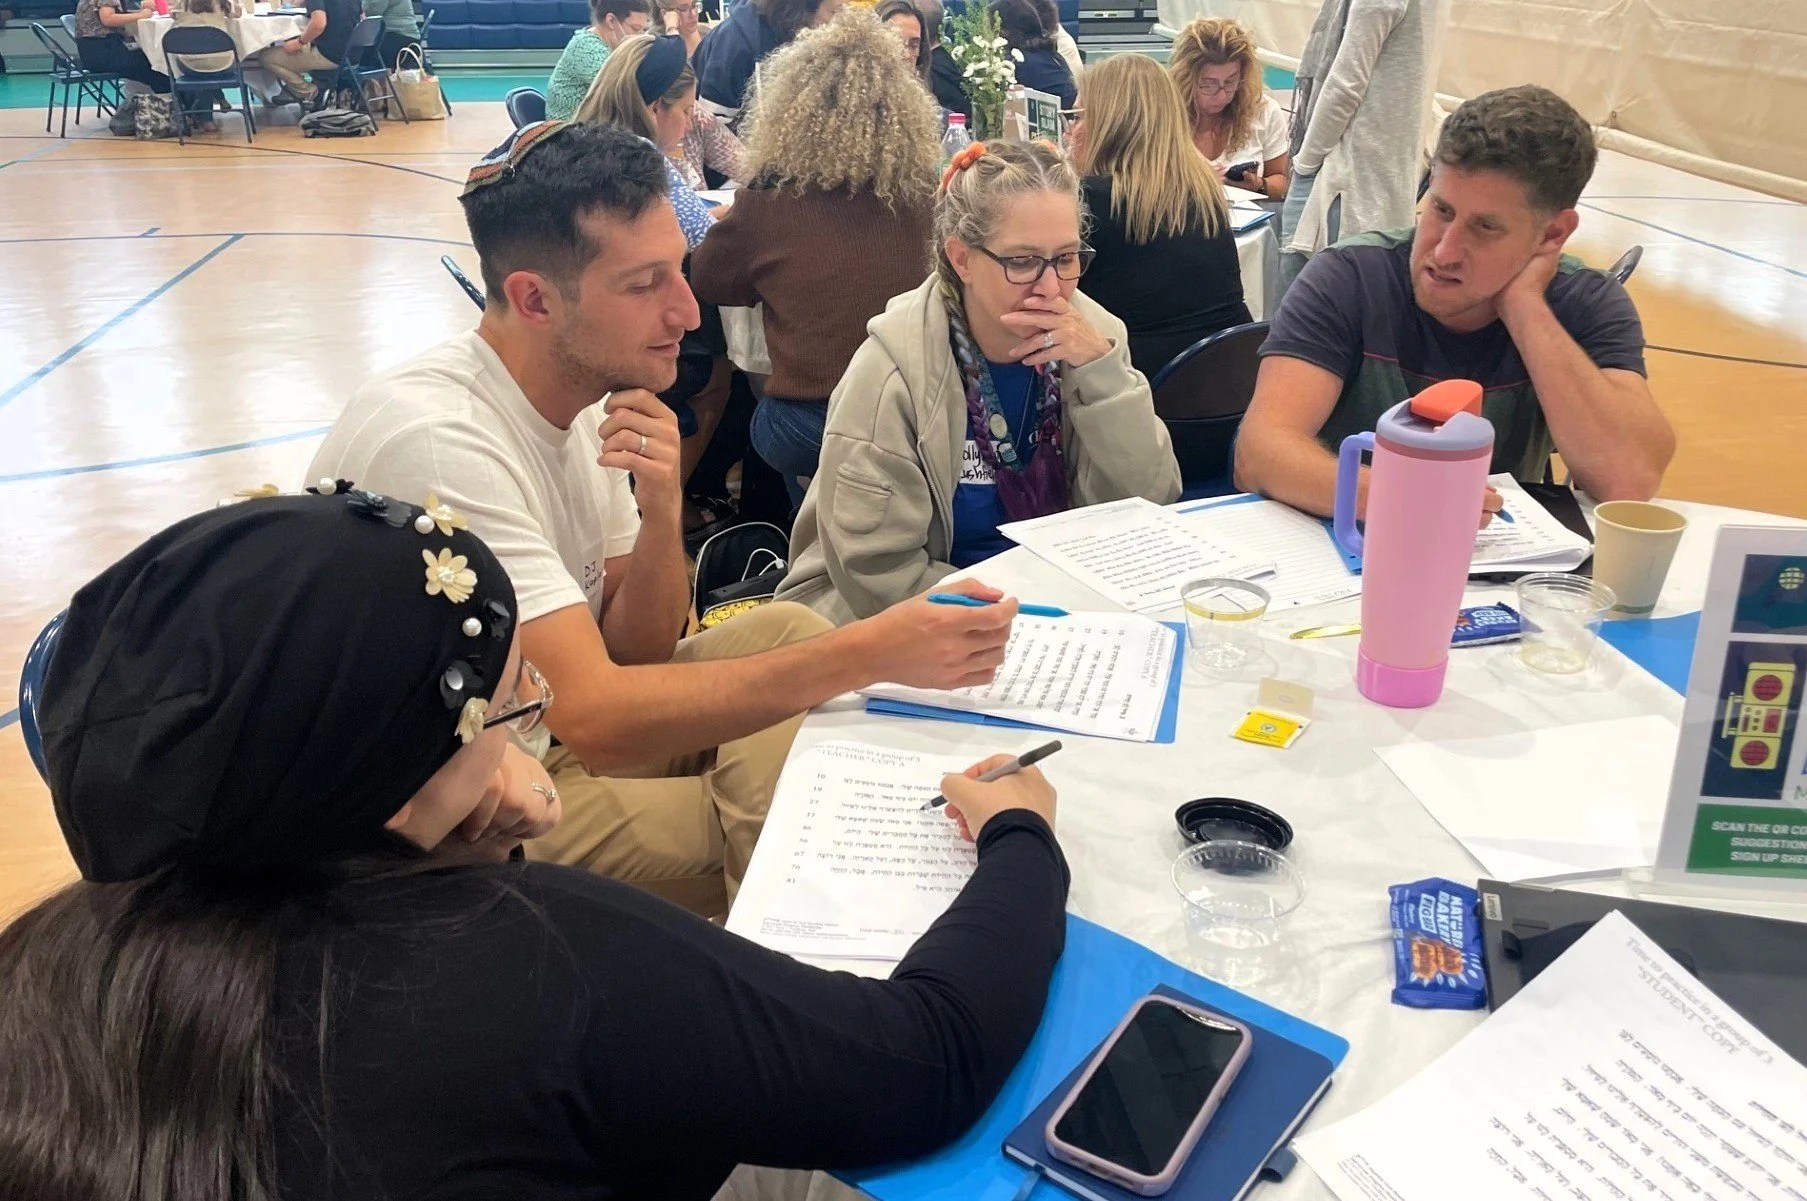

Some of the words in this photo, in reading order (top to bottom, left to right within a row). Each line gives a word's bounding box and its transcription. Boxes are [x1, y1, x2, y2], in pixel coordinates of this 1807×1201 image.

[963, 444, 981, 467] olly
[1711, 821, 1745, 832] SCAN
[1747, 823, 1771, 833] THE
[1772, 824, 1789, 834] QR
[1730, 851, 1760, 861] SIGN
[1762, 852, 1779, 862] UP
[1421, 897, 1433, 916] FIG
[1702, 1024, 1740, 1054] COPY
